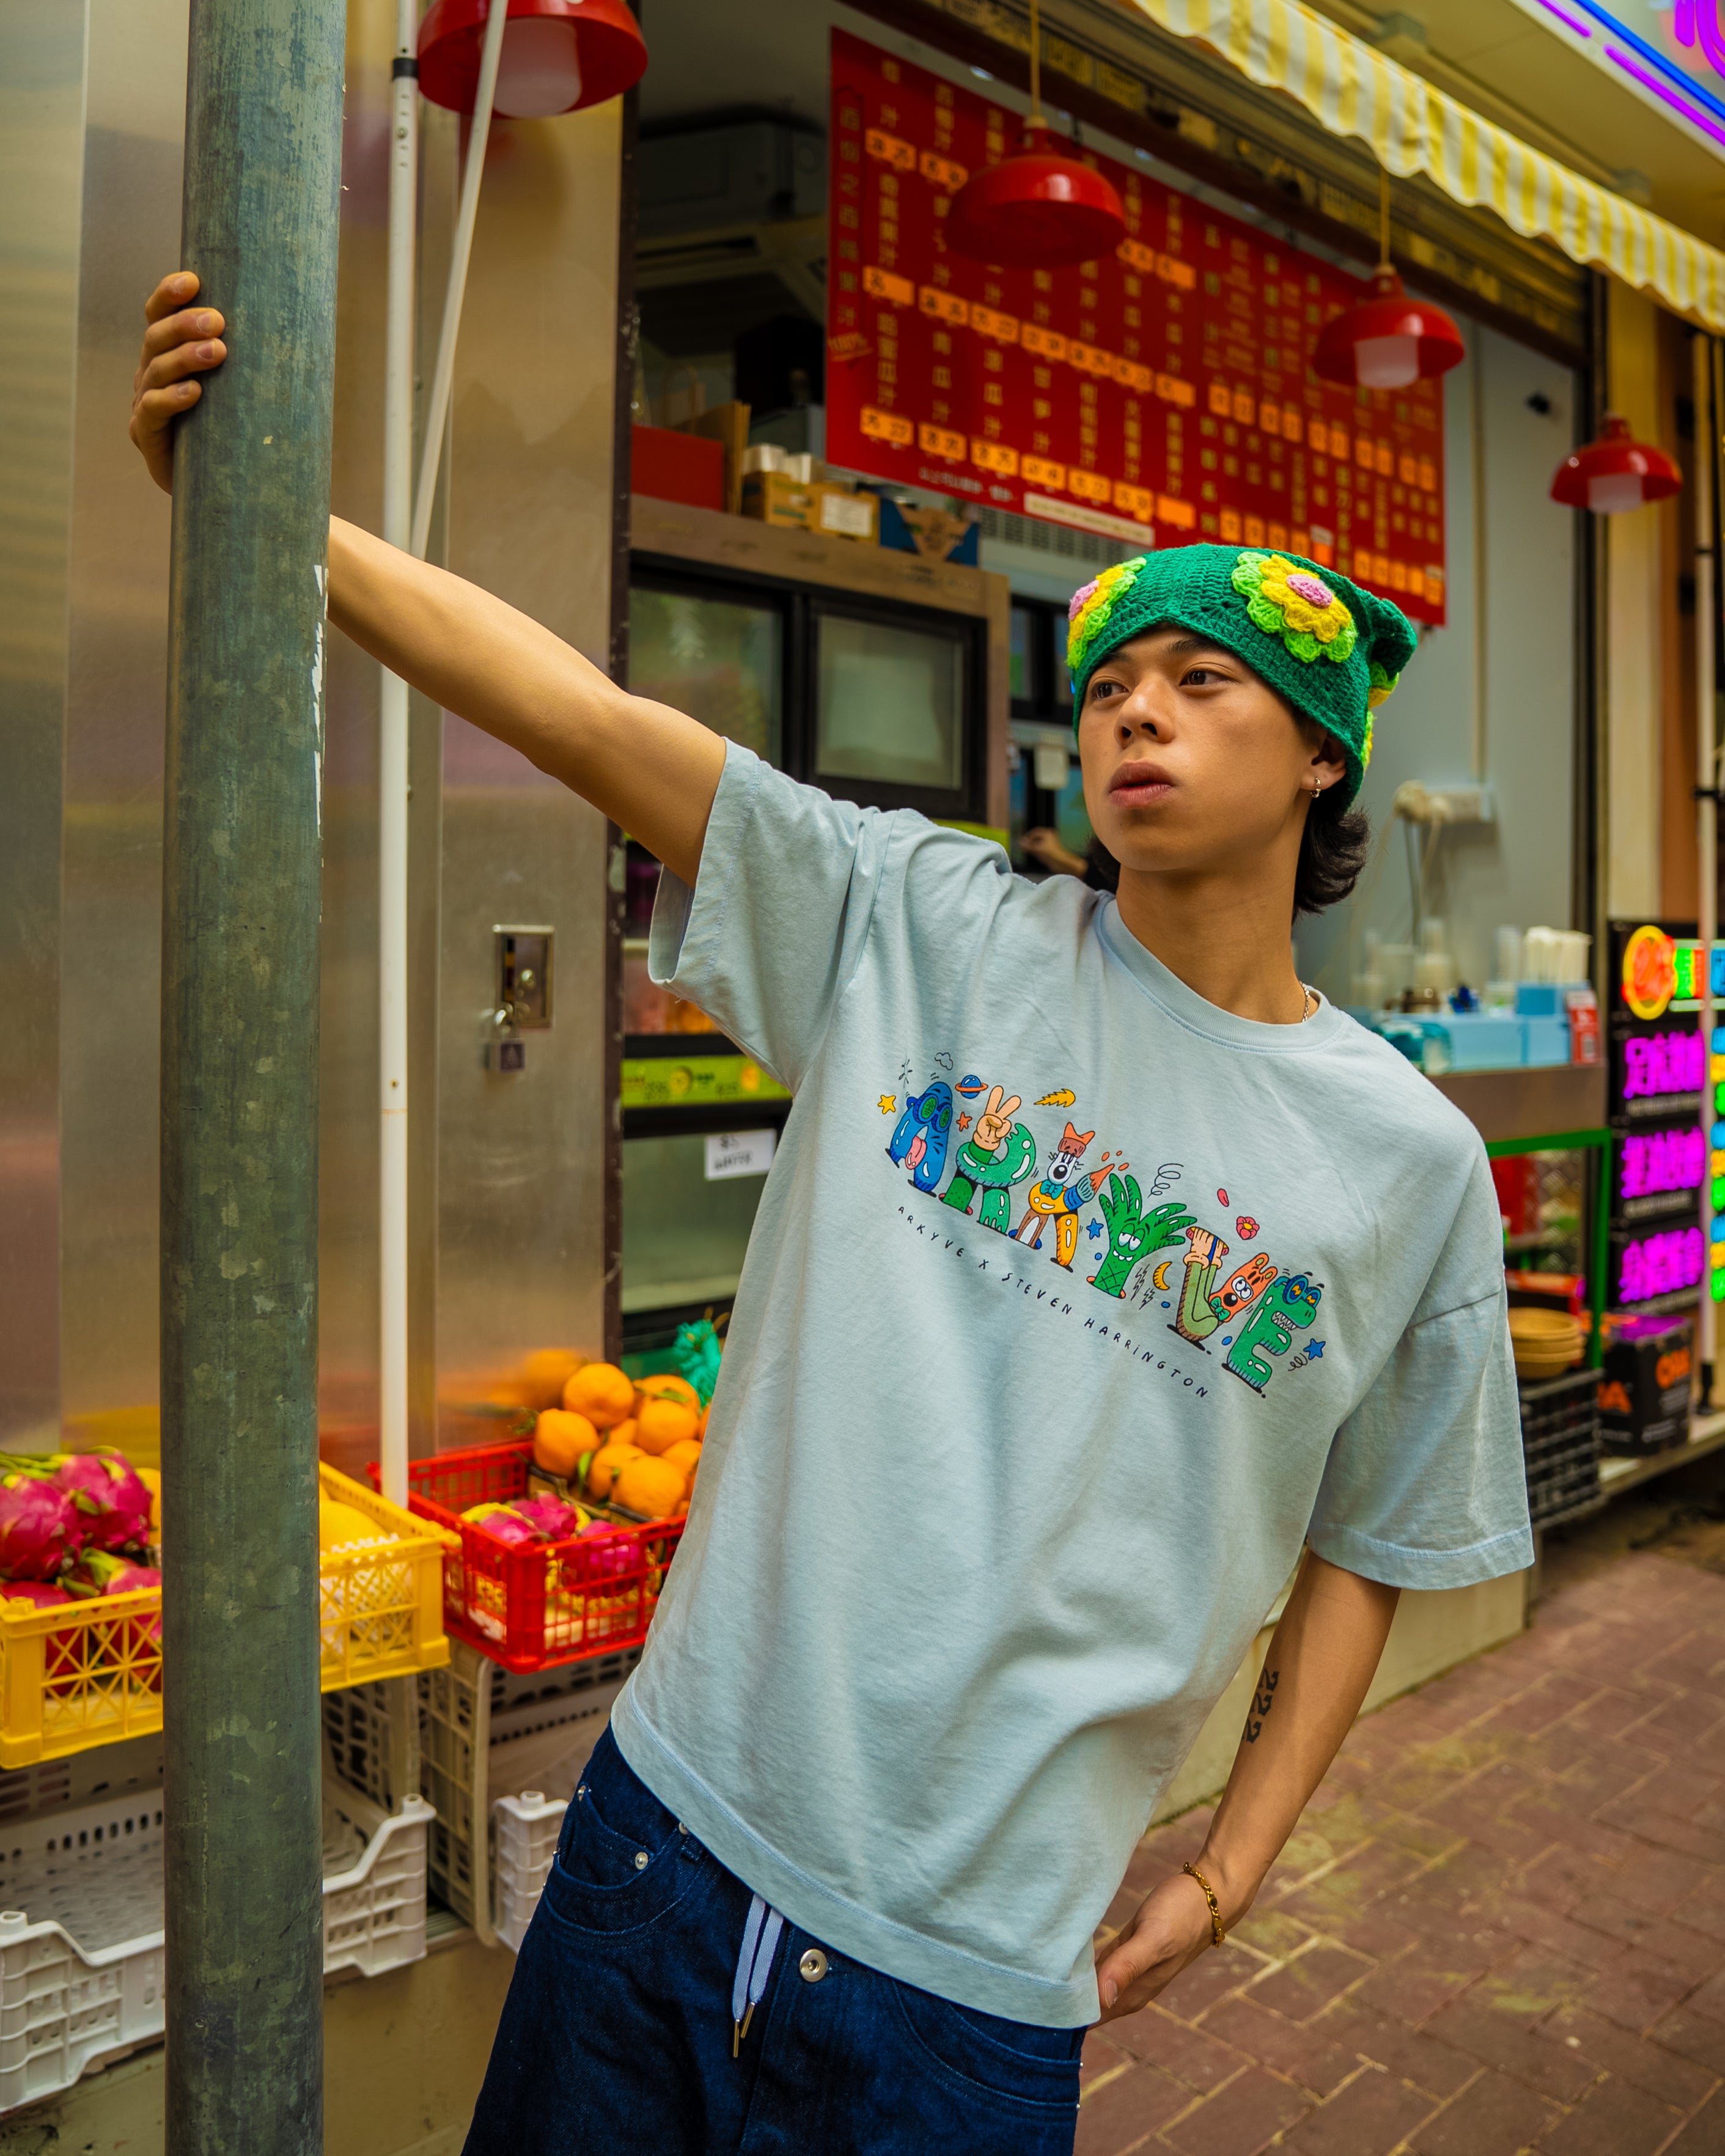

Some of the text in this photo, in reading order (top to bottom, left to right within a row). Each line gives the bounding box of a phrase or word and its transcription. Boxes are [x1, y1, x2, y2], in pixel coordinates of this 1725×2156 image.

[898, 1206, 965, 1257] ARKYVE
[978, 1259, 989, 1270] X
[1001, 1272, 1072, 1315] STEVEN
